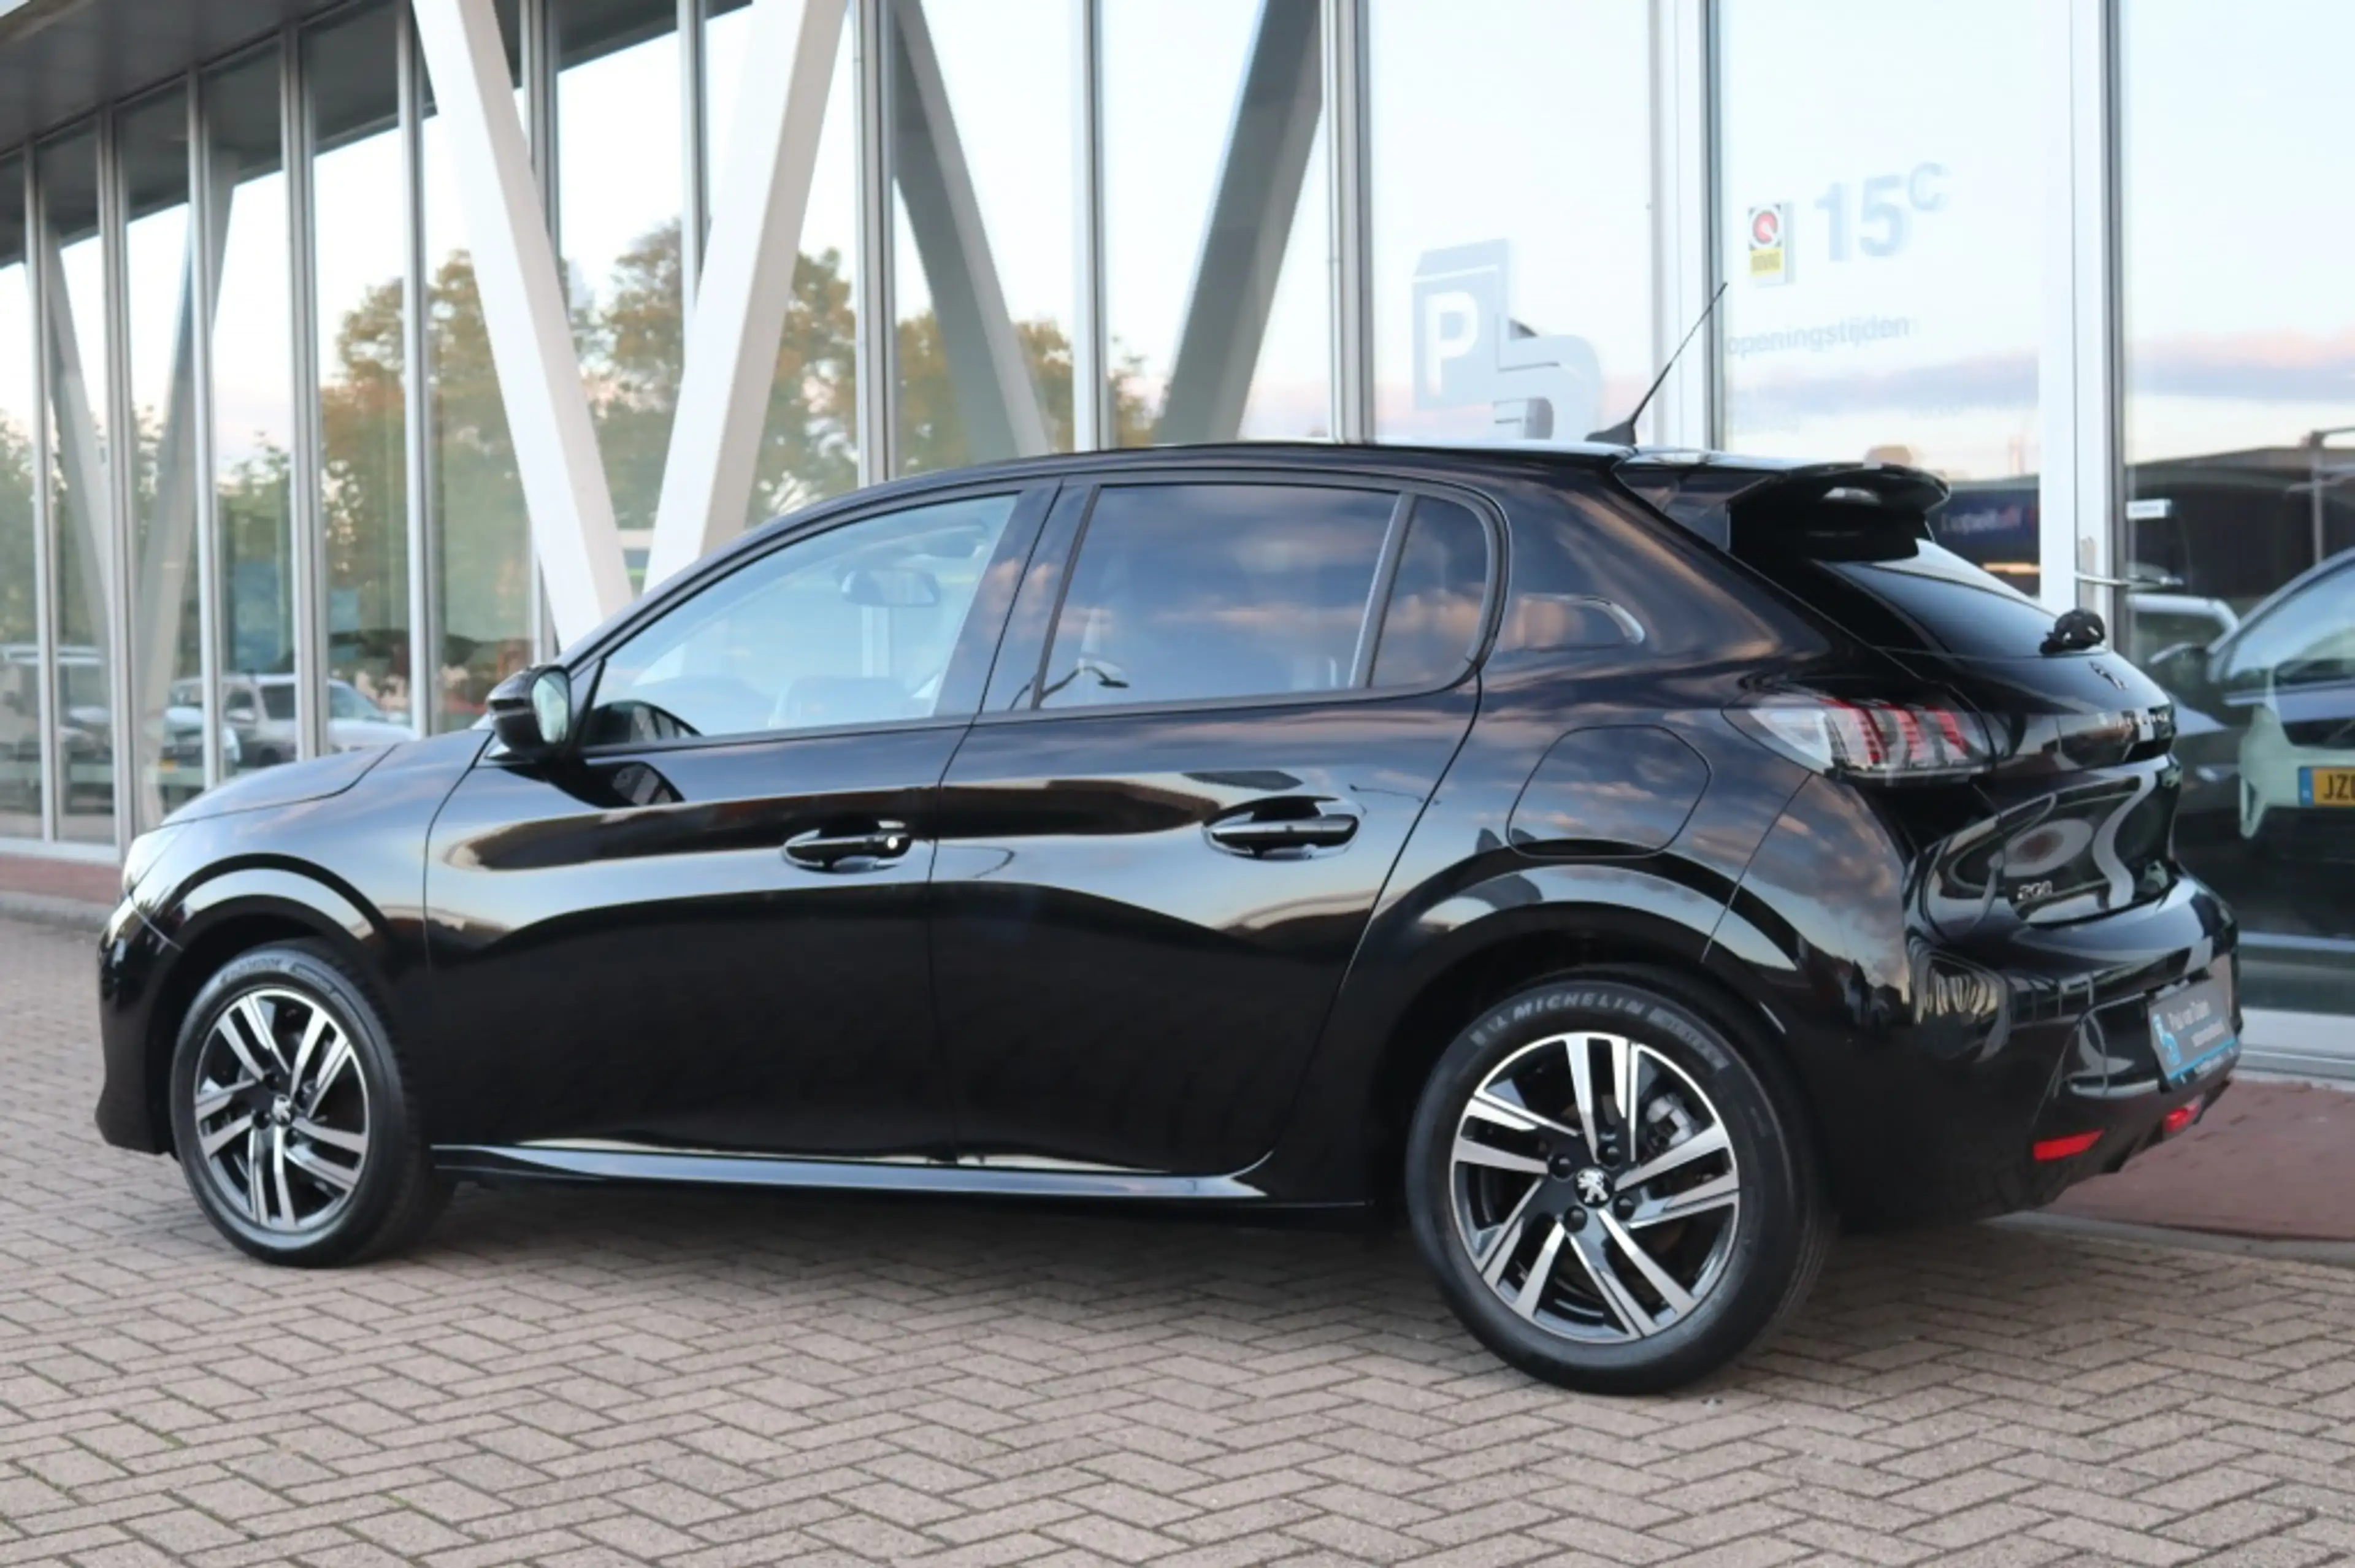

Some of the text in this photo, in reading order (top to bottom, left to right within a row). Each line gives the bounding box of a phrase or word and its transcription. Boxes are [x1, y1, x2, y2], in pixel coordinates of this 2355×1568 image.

[1423, 291, 1477, 396] P
[1727, 315, 1909, 359] openingstijden
[1512, 992, 1645, 1020] MICHELIN
